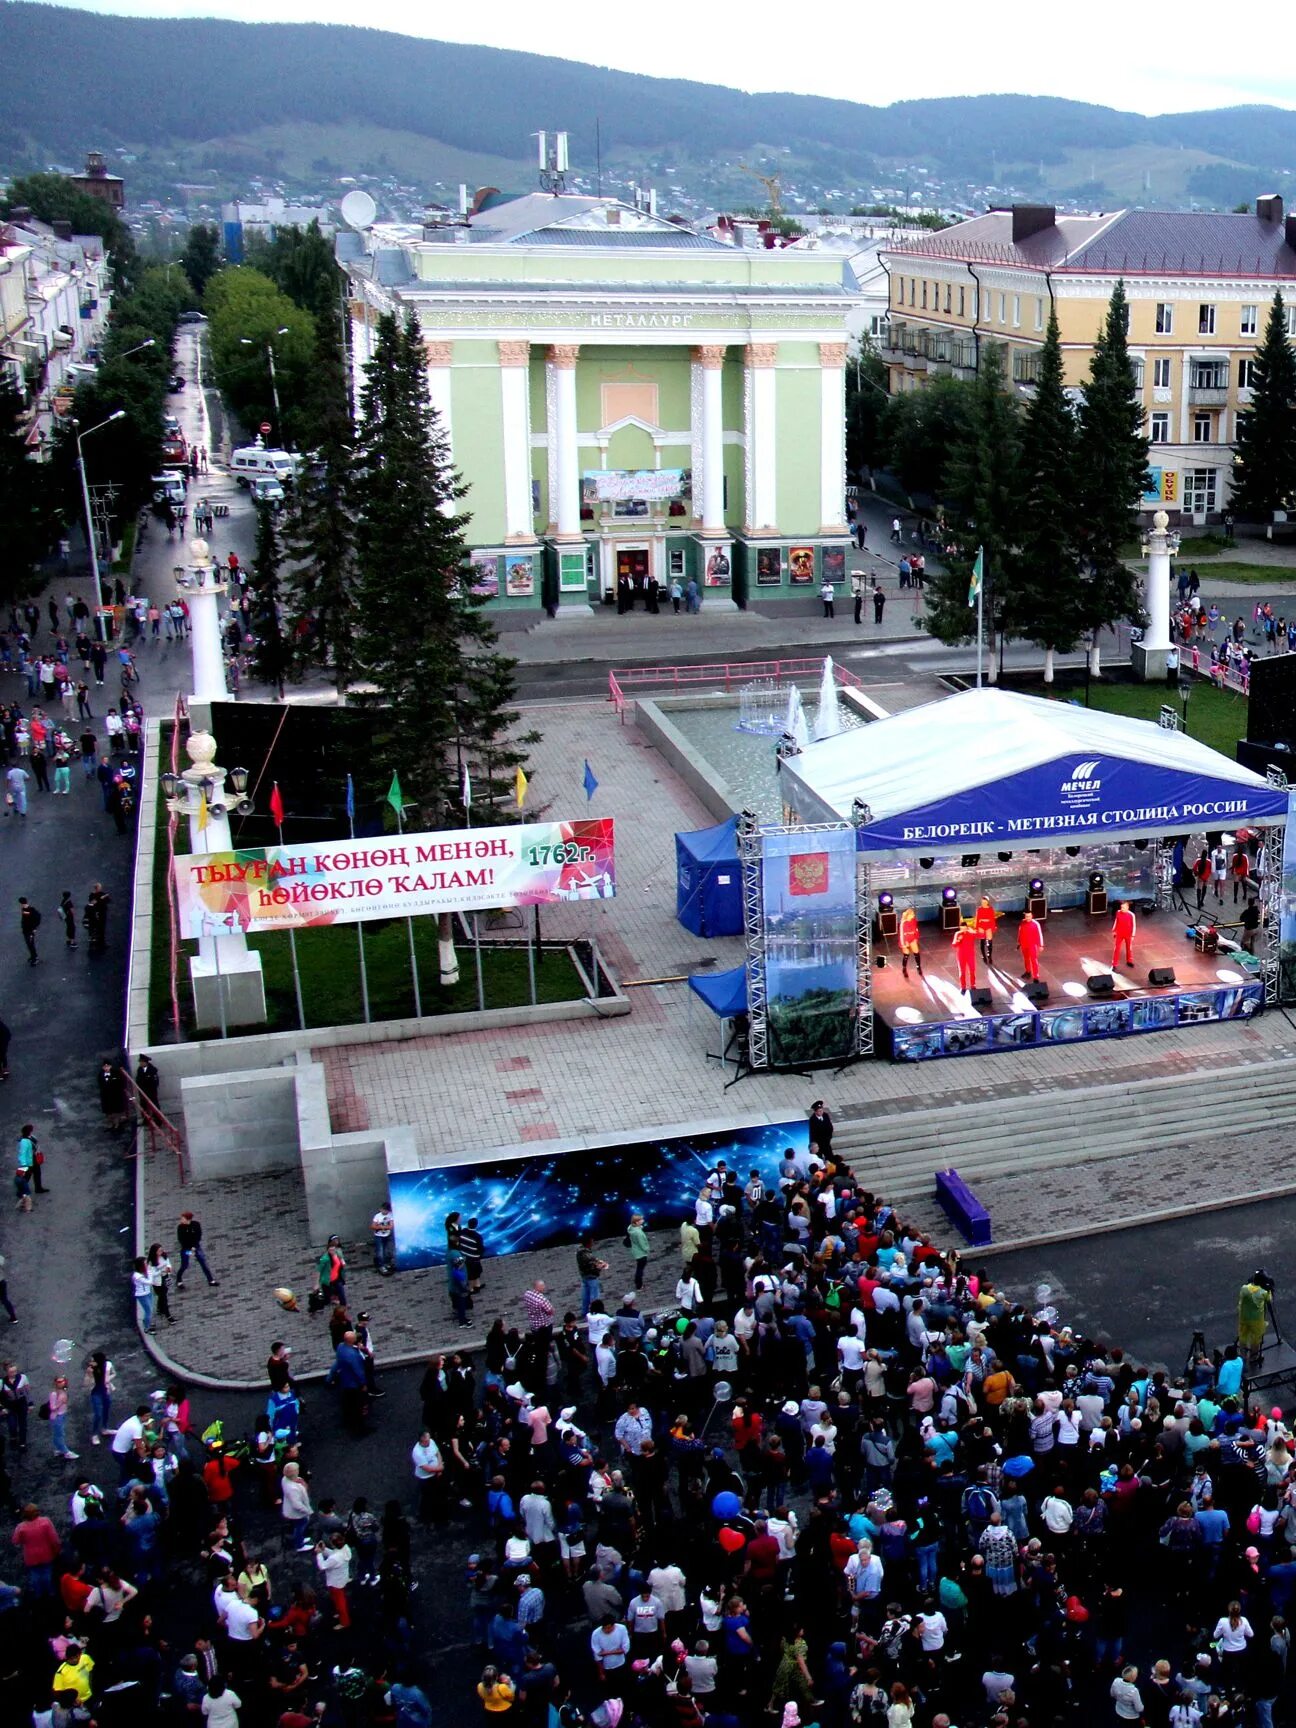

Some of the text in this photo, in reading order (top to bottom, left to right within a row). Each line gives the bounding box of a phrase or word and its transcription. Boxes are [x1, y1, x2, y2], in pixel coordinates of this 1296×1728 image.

[591, 314, 693, 327] МЕТАЛЛУРГ
[1165, 472, 1174, 501] ОБУВЬ
[1061, 780, 1101, 792] МЕЧЕЛ
[903, 821, 995, 840] БЕЛОРЕЦК
[1008, 812, 1098, 832] МЕТИЗНАЯ
[1101, 806, 1179, 824] СТОЛИЦА
[1183, 800, 1248, 817] РОССИИ
[191, 839, 514, 884] ТЫУҒАН КӨНӨҢ МЕНӘН,
[529, 842, 596, 866] 1762г.
